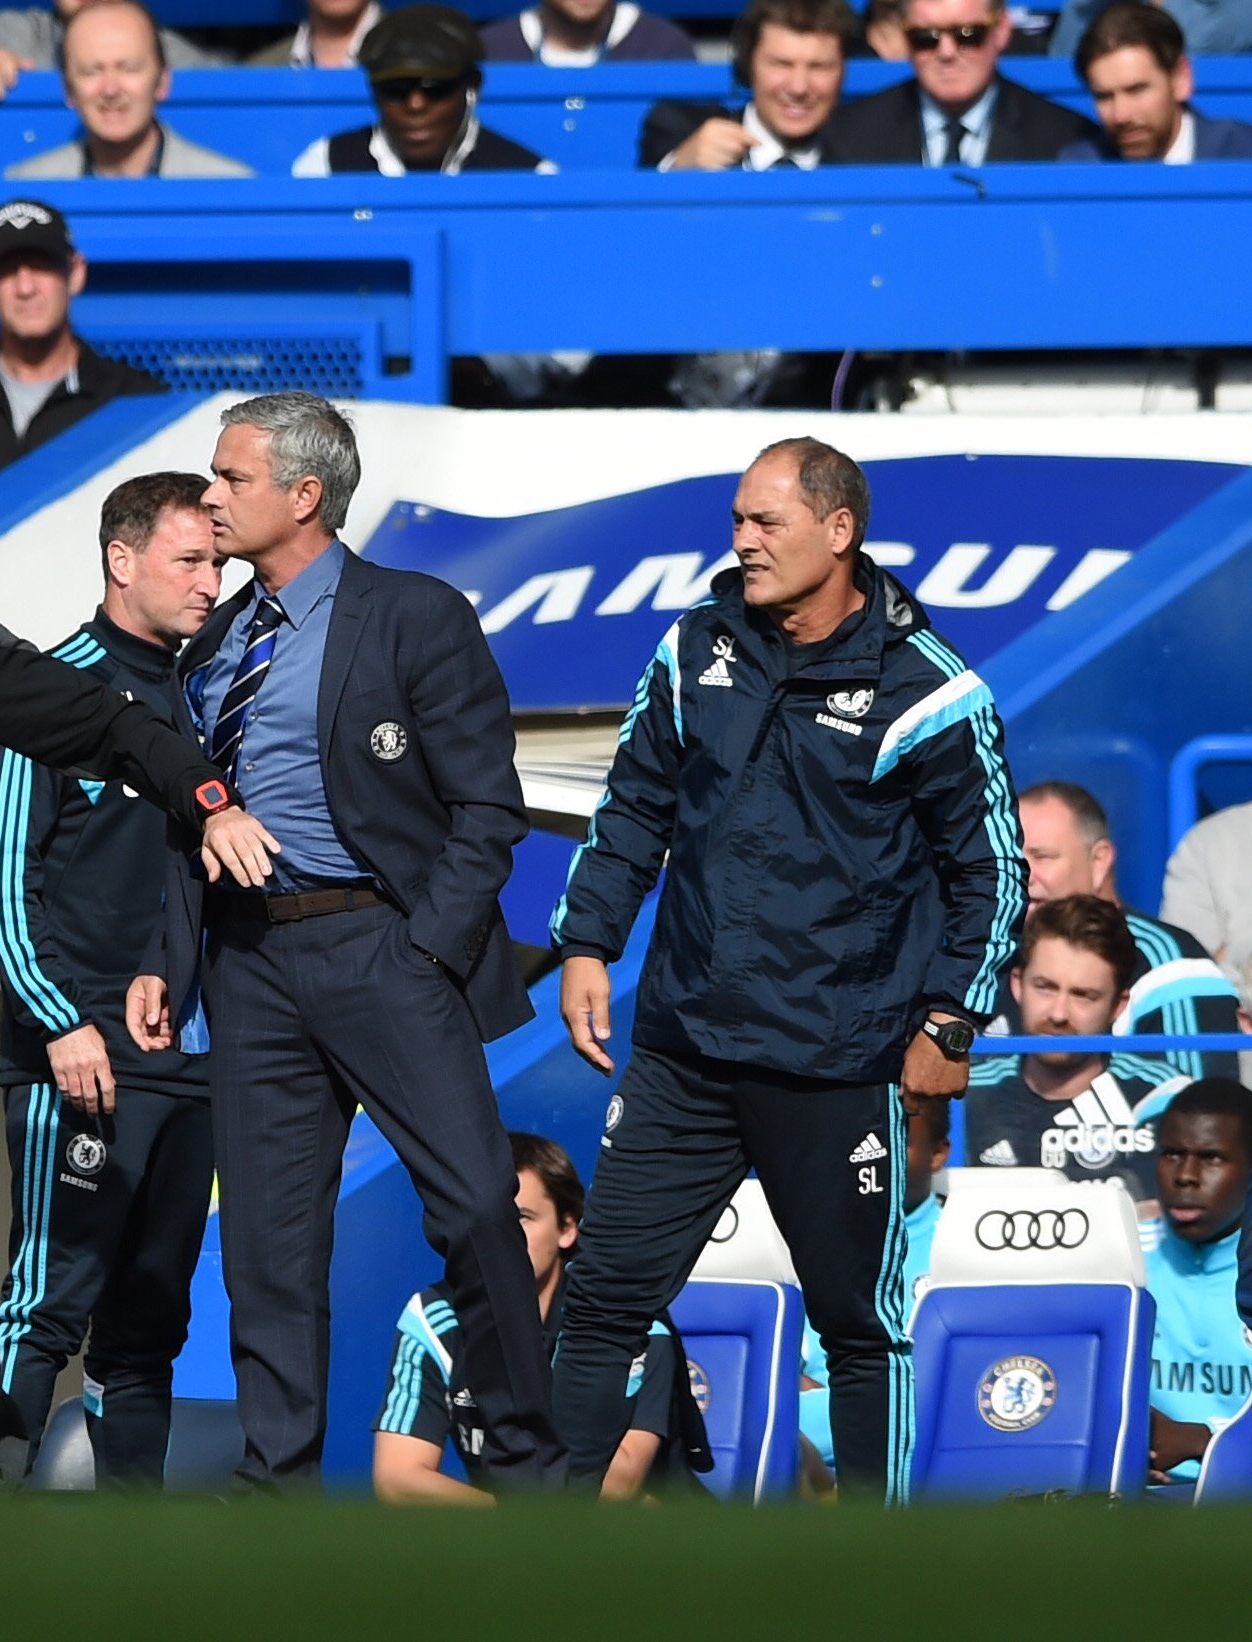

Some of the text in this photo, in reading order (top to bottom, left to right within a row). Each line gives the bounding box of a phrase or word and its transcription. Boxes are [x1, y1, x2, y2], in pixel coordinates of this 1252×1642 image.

[461, 540, 1132, 636] AMU
[712, 635, 738, 663] SL
[1041, 1122, 1156, 1154] adidas
[858, 1165, 884, 1195] SL
